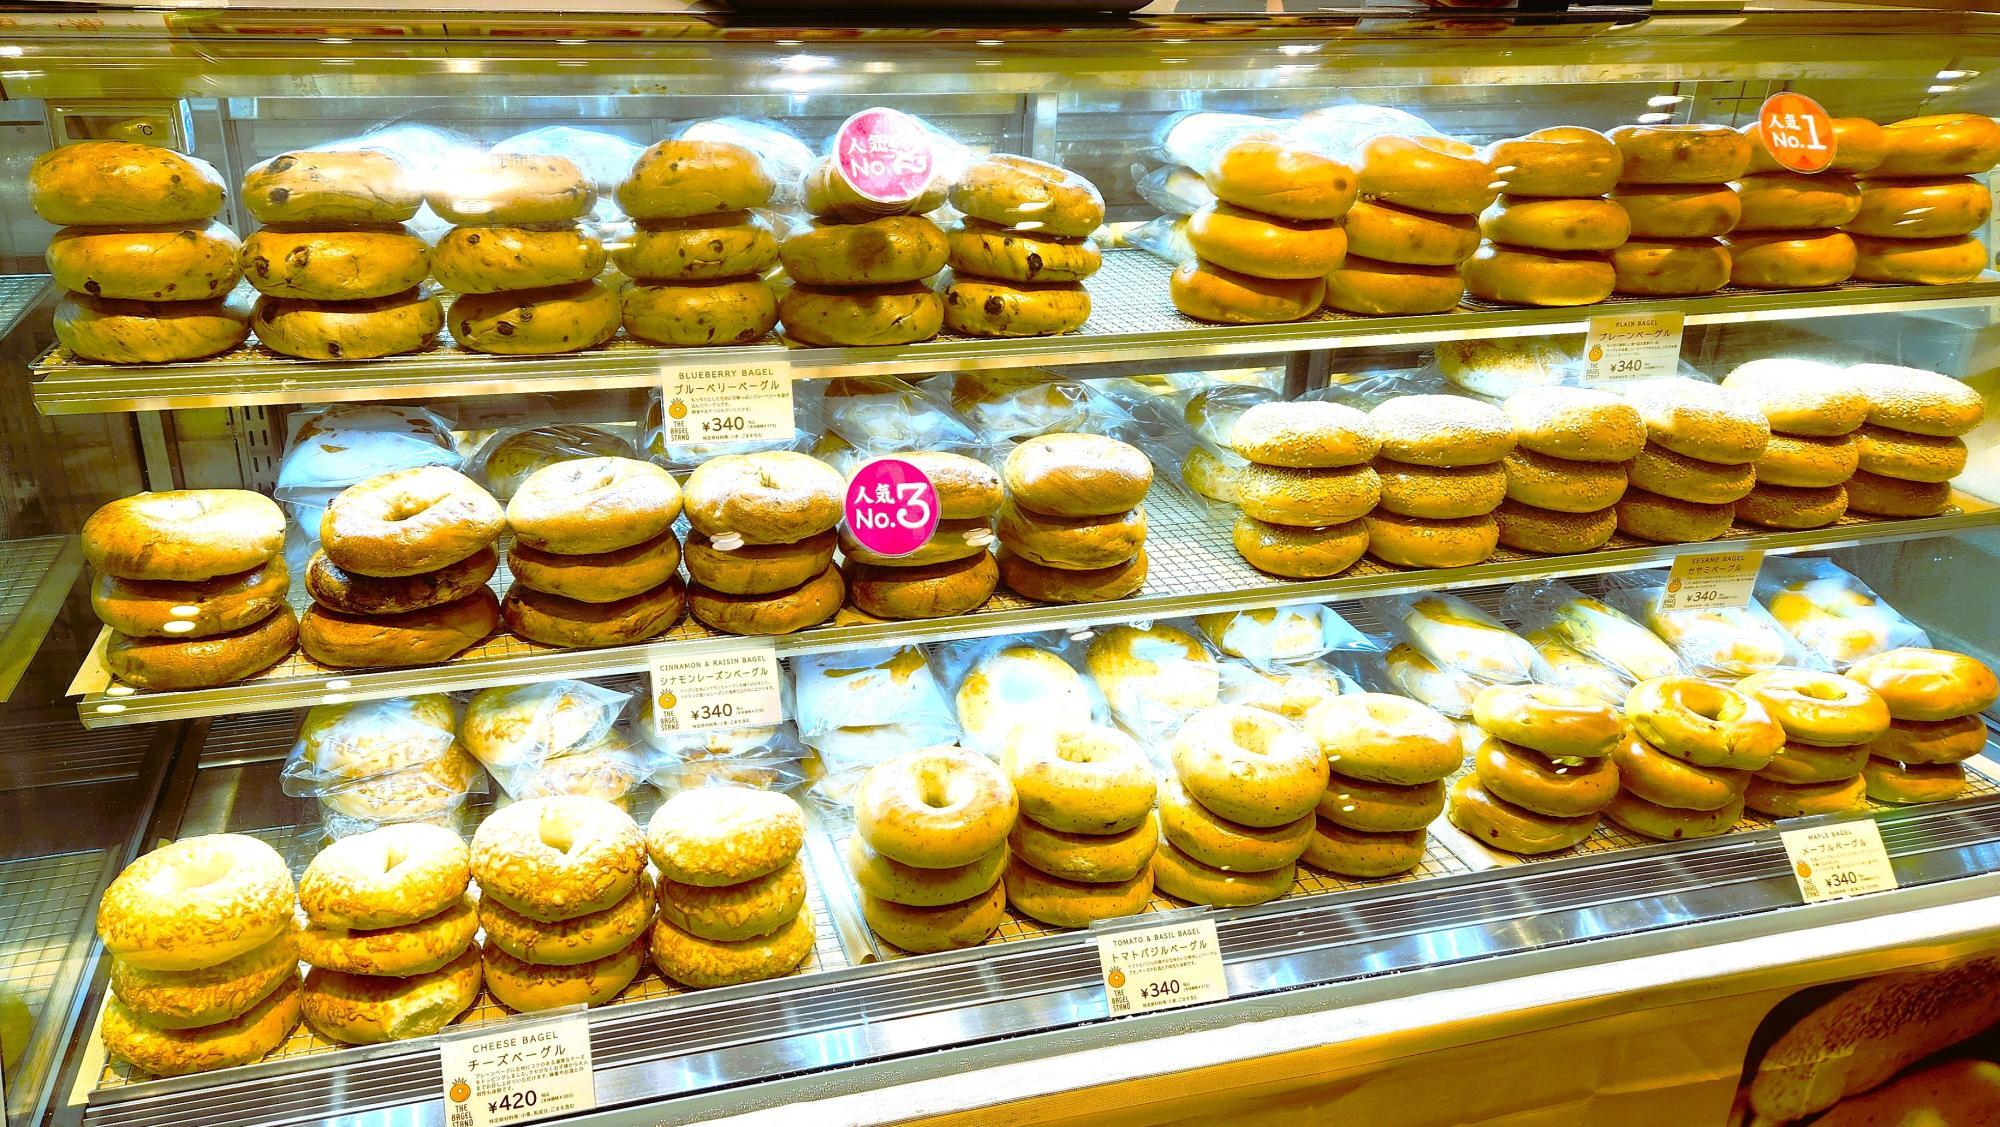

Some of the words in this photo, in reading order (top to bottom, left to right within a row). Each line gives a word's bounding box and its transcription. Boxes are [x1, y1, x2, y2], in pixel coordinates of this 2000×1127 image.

[1768, 112, 1802, 131] 人気
[1600, 329, 1672, 341] プレーンベーグル
[679, 370, 737, 380] BLUEBERRY
[741, 368, 774, 376] BAGEL
[1610, 359, 1642, 373] ¥340
[675, 380, 780, 395] ブルーベリーベーグル
[702, 416, 745, 432] ¥340
[854, 482, 895, 504] 人気
[855, 482, 930, 530] No.3
[1688, 564, 1742, 575] セサミベーグル
[1687, 590, 1717, 602] ¥340
[659, 662, 701, 671] CINNAMON
[712, 658, 739, 666] RAISIN
[742, 655, 766, 663] BAGEL
[660, 667, 768, 686] シナモンレーズンベーグル
[691, 703, 733, 720] ¥340
[1808, 833, 1830, 841] MAPLE
[1802, 838, 1867, 855] メープルベーグル
[1825, 871, 1857, 888] ¥340
[1113, 937, 1144, 947] TOMATO
[1154, 932, 1175, 941] BASIL
[1177, 928, 1201, 937] BAGEL
[1112, 940, 1207, 963] トマトバジルベーグル
[1140, 979, 1180, 999] ¥340
[472, 1038, 517, 1053] CHEESE
[522, 1031, 559, 1045] BAGEL
[468, 1044, 566, 1072] チーズベーグル
[455, 1104, 468, 1113] THE
[488, 1090, 537, 1114] ¥420
[452, 1112, 472, 1121] BAGEL
